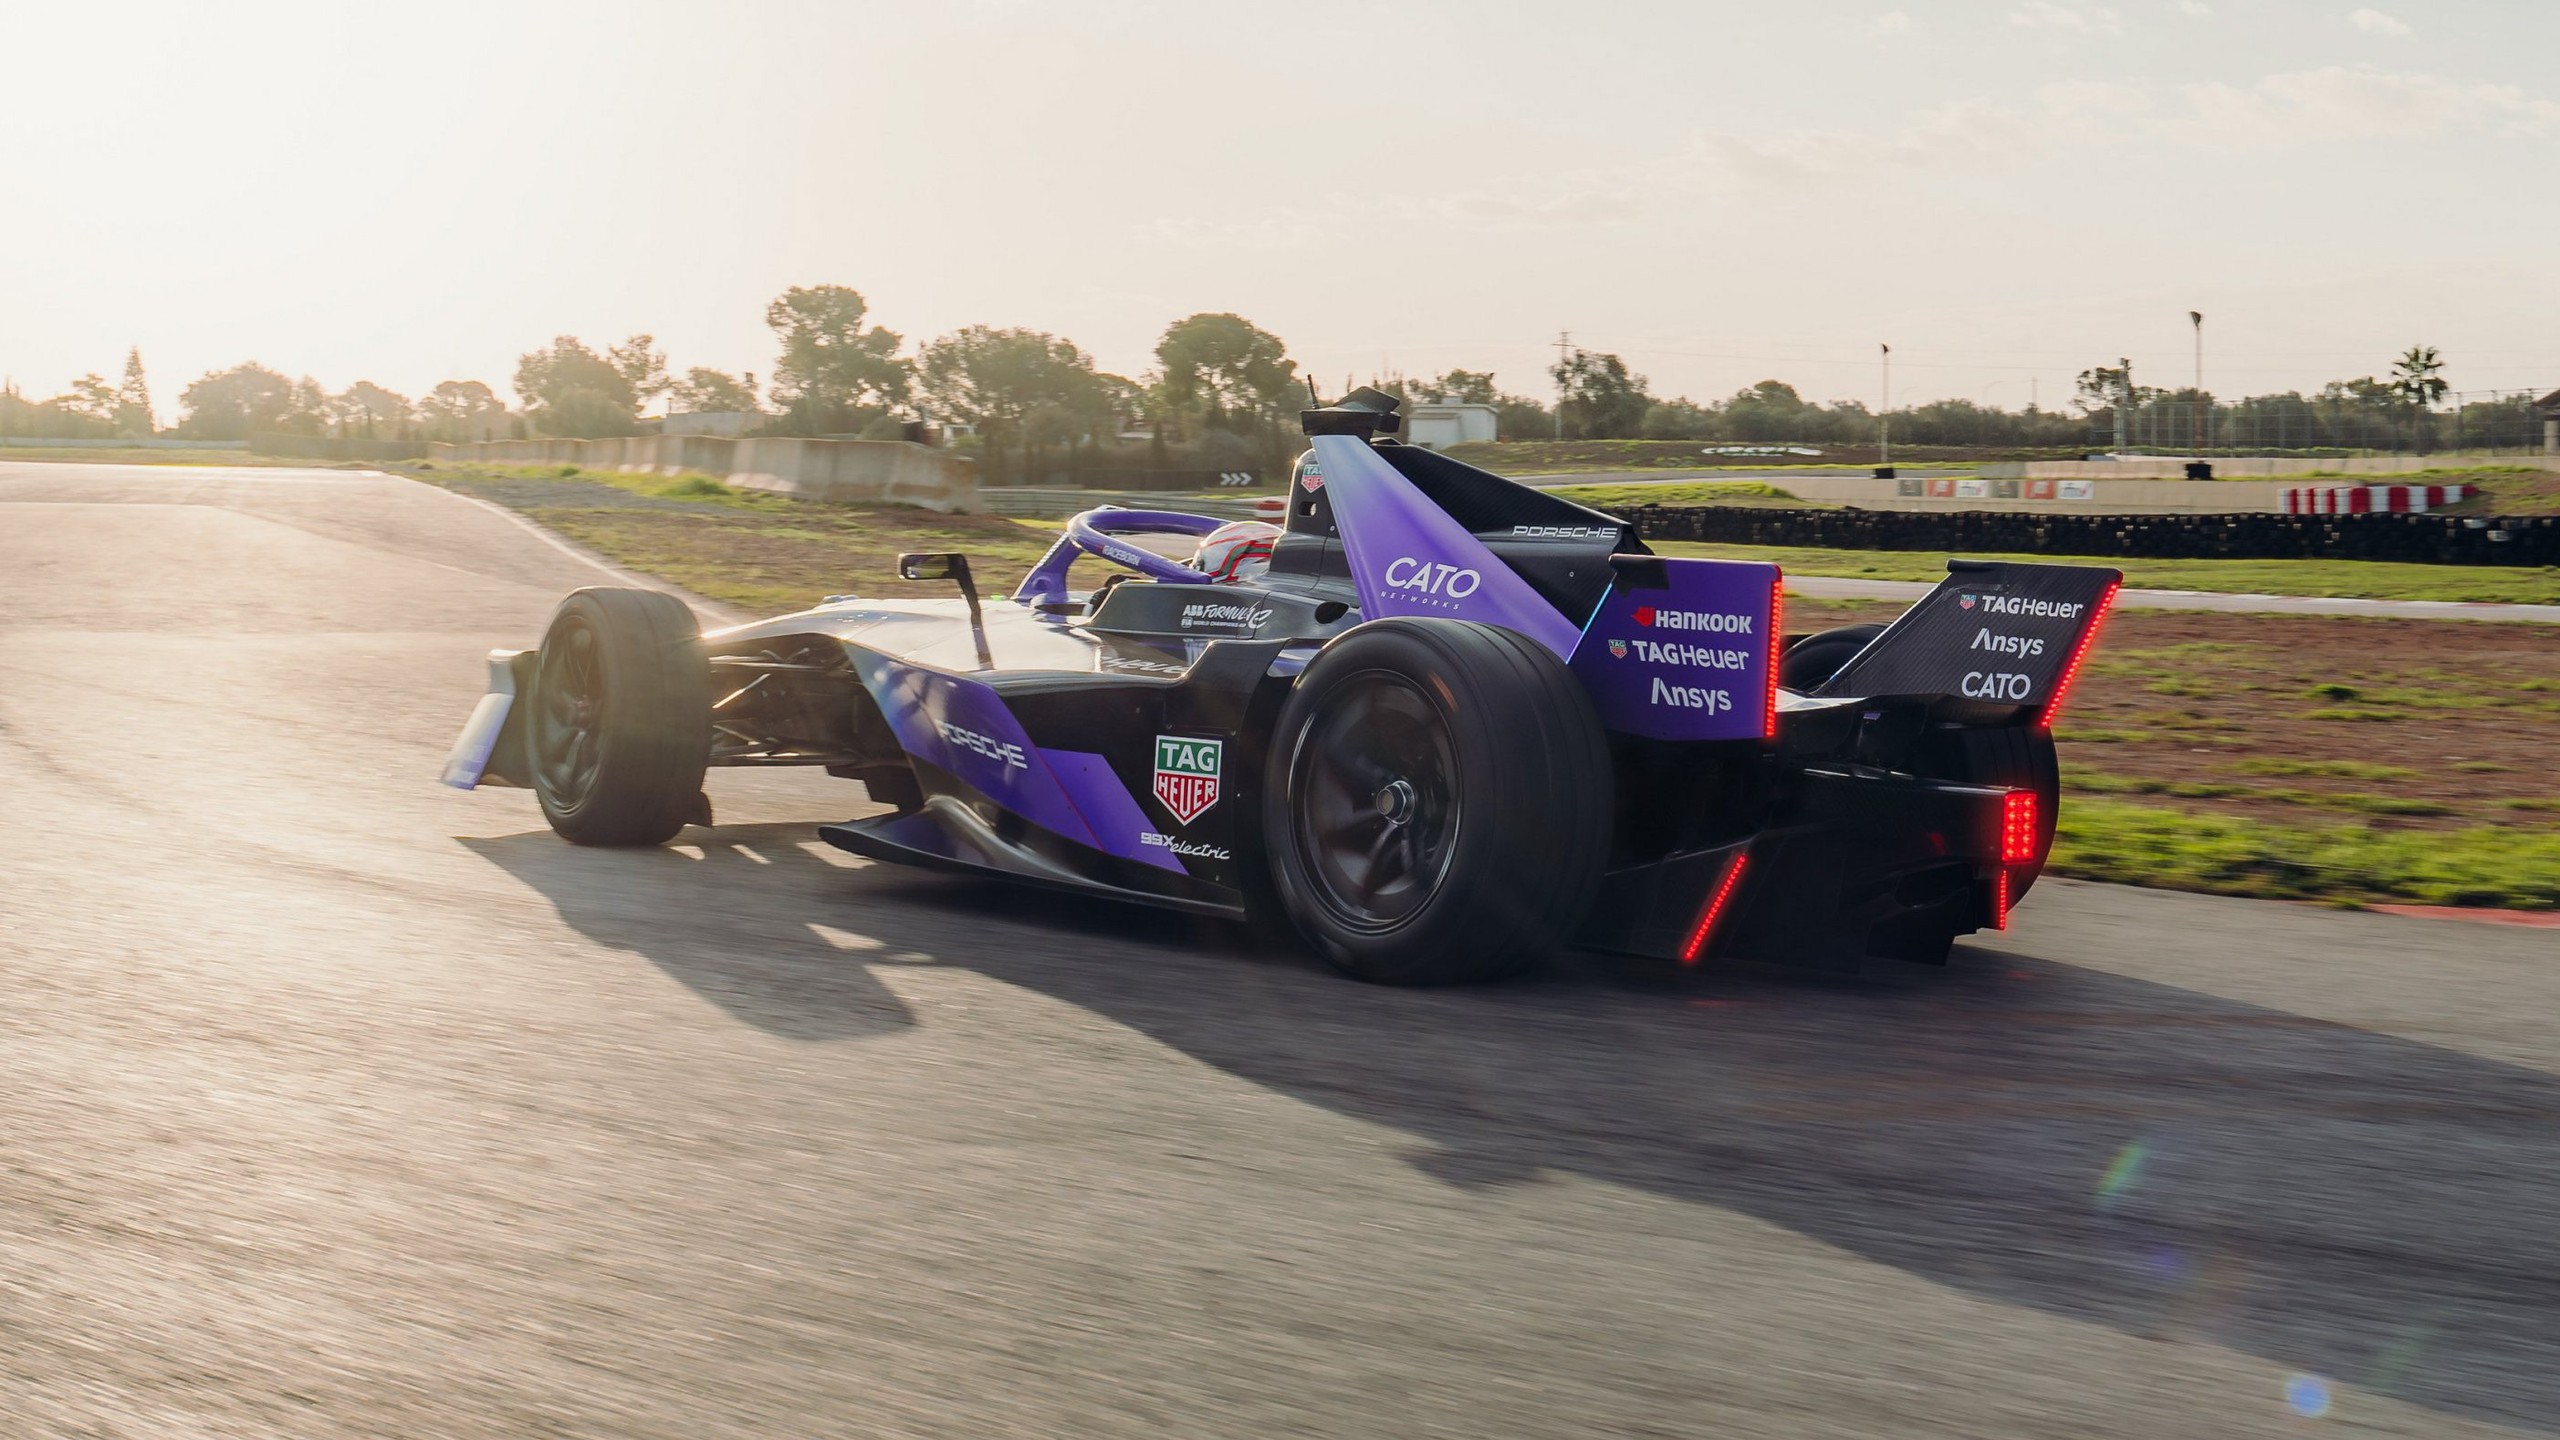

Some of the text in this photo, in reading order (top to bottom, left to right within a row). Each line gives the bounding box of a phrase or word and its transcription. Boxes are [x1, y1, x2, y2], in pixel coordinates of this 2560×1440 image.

[1512, 525, 1618, 538] PORSCHE
[1385, 557, 1481, 598] CATO
[1380, 591, 1460, 610] NETWORKS
[1970, 627, 2044, 659] Ansys
[1651, 677, 1732, 716] Ansys
[1961, 671, 2031, 700] CATO
[934, 719, 1028, 769] PORSCHE
[1162, 742, 1215, 772] TAG
[1158, 775, 1216, 818] HEUER
